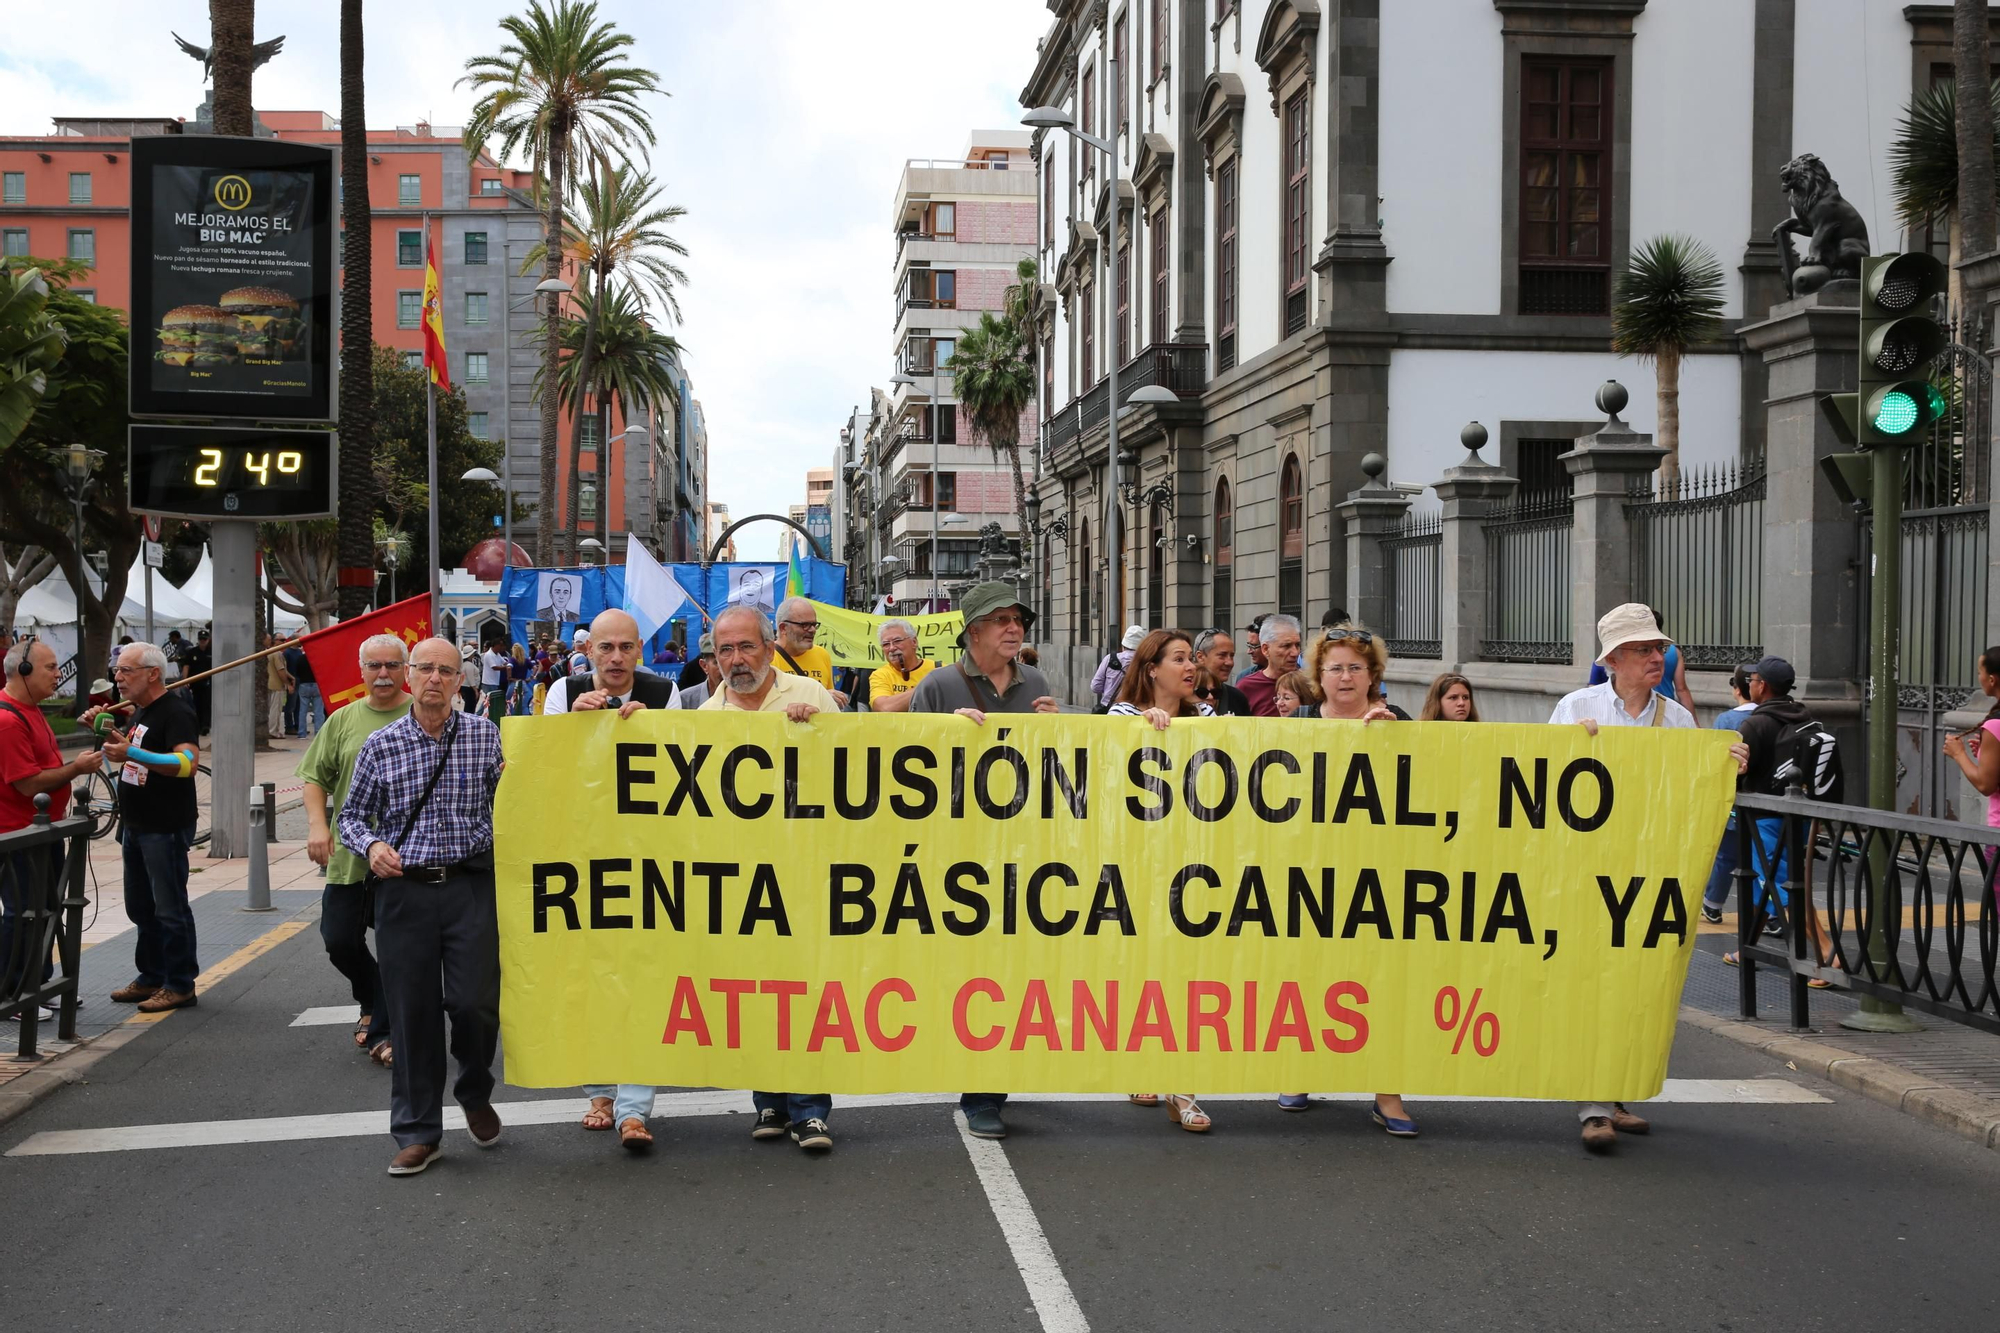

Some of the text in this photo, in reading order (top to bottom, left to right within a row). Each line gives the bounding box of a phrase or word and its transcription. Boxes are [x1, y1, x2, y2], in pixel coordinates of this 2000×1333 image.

[175, 213, 292, 231] MEJORAMOS EL
[200, 229, 226, 242] BIG
[191, 265, 216, 273] lechuga
[276, 260, 312, 268] tradicional.
[616, 728, 1614, 843] EXCLUSIÓN SOCIAL, NO
[532, 844, 1689, 962] RENTA BÁSICA CANARIA, YA
[662, 976, 1501, 1058] ATTAC CANARIAS %
